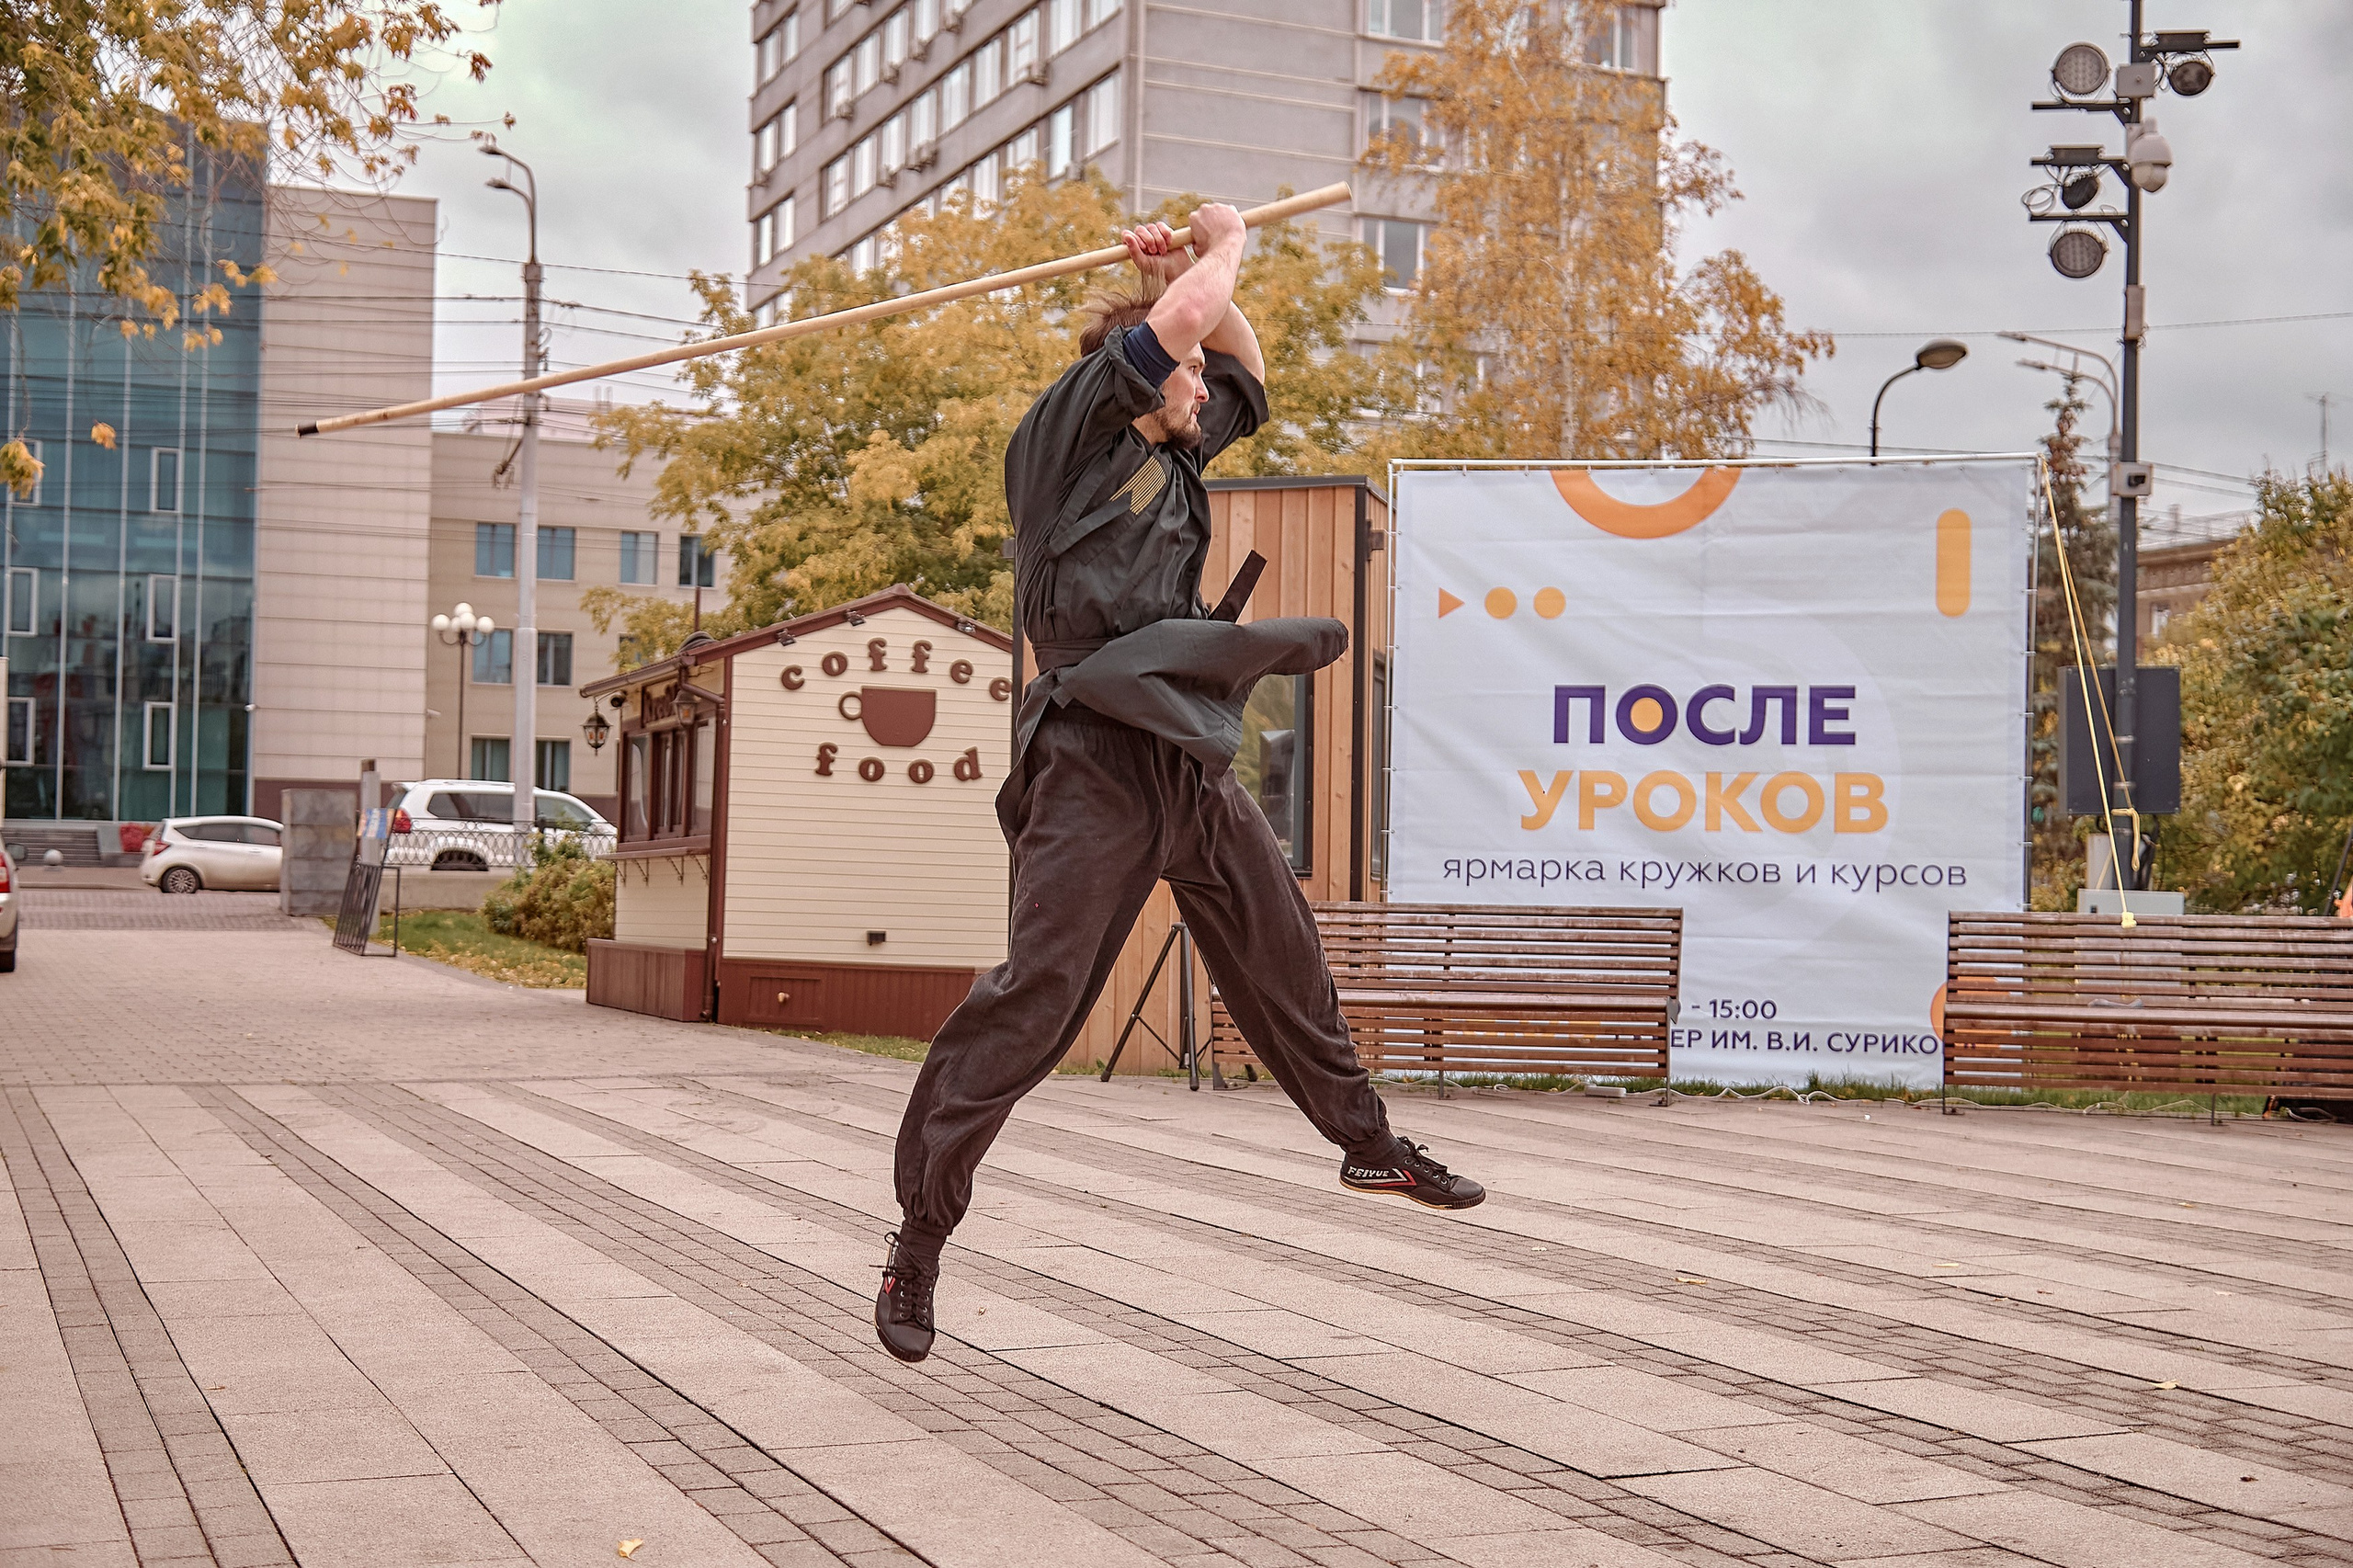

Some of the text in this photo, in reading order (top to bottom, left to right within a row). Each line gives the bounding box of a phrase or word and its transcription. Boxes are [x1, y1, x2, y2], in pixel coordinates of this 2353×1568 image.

[780, 637, 1012, 702] coffee
[1552, 683, 1857, 745] ПОСЛЕ
[813, 741, 983, 784] food
[1517, 769, 1890, 834] УРОКОВ
[1443, 858, 1967, 893] ярмарка кружков и курсов
[1709, 999, 1778, 1019] 15:00
[1670, 1028, 1943, 1055] ЕР ИМ. В.И. СУРИКО
[1347, 1165, 1390, 1177] FEIYUE
